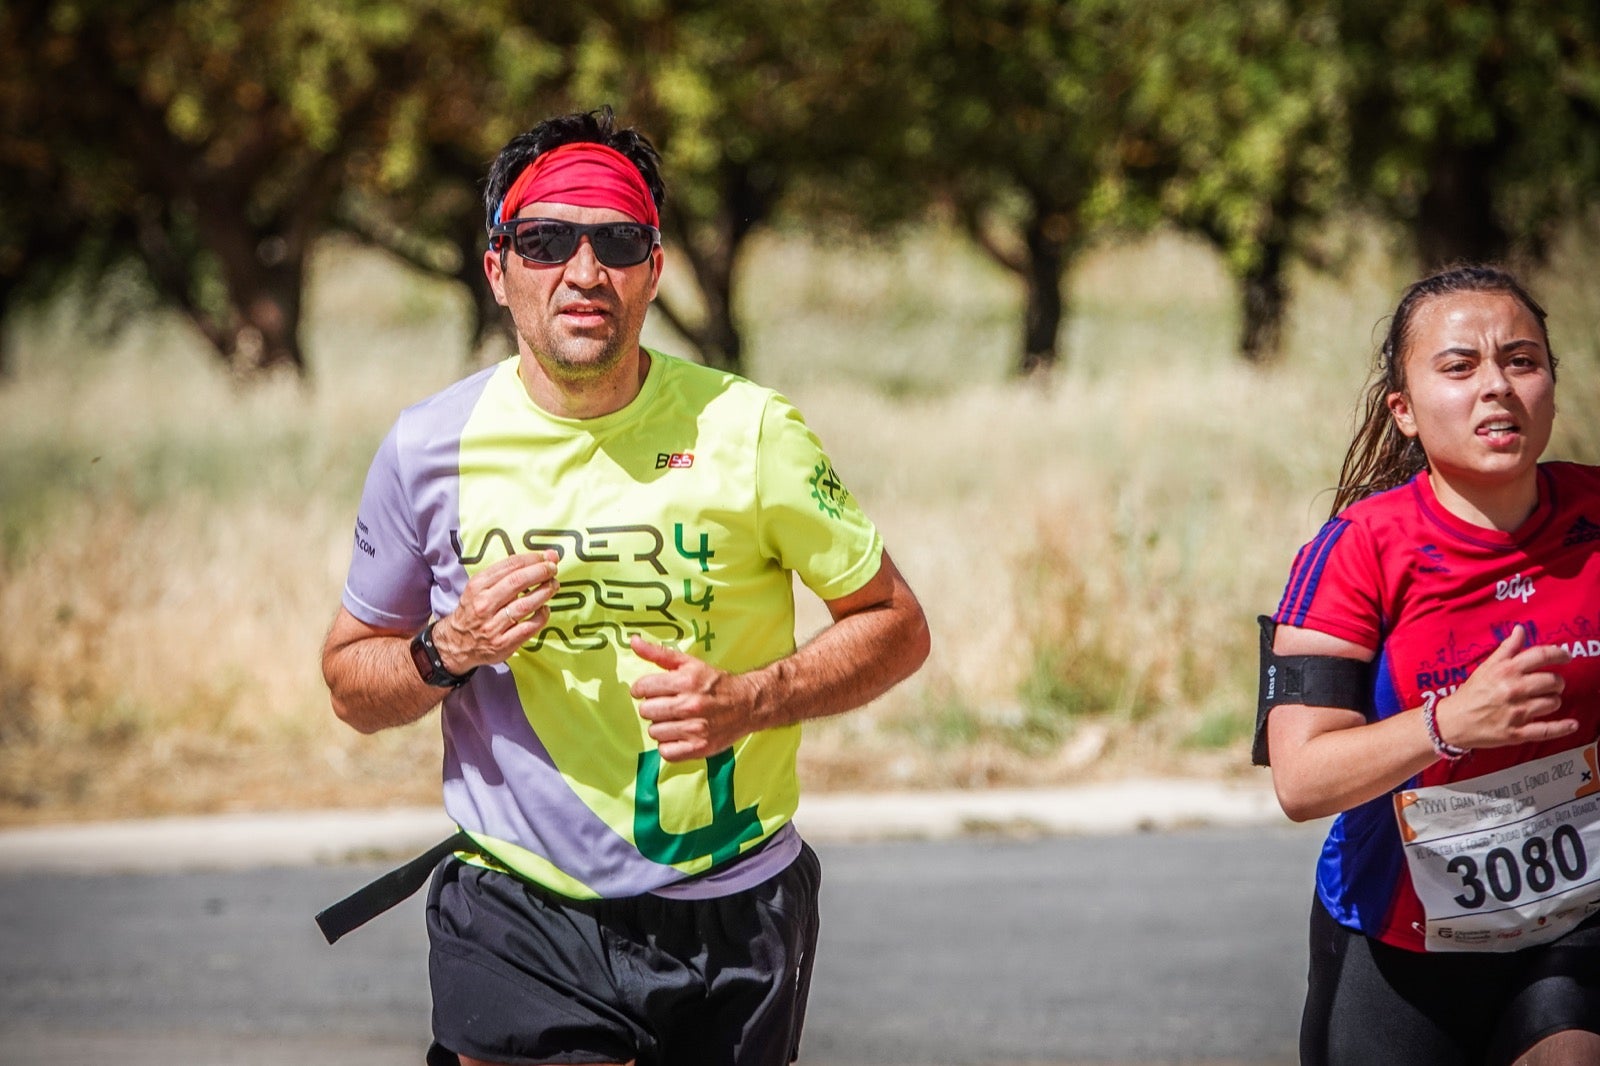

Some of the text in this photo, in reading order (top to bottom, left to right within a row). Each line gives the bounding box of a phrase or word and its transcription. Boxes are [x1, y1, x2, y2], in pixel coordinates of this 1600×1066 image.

[450, 523, 715, 575] LASER 4
[522, 579, 714, 621] SER 4
[1495, 573, 1536, 604] edp
[692, 618, 715, 652] 4
[1417, 665, 1467, 690] RUN
[1551, 760, 1574, 781] 2022
[634, 745, 764, 867] 4
[1446, 824, 1587, 909] 3080
